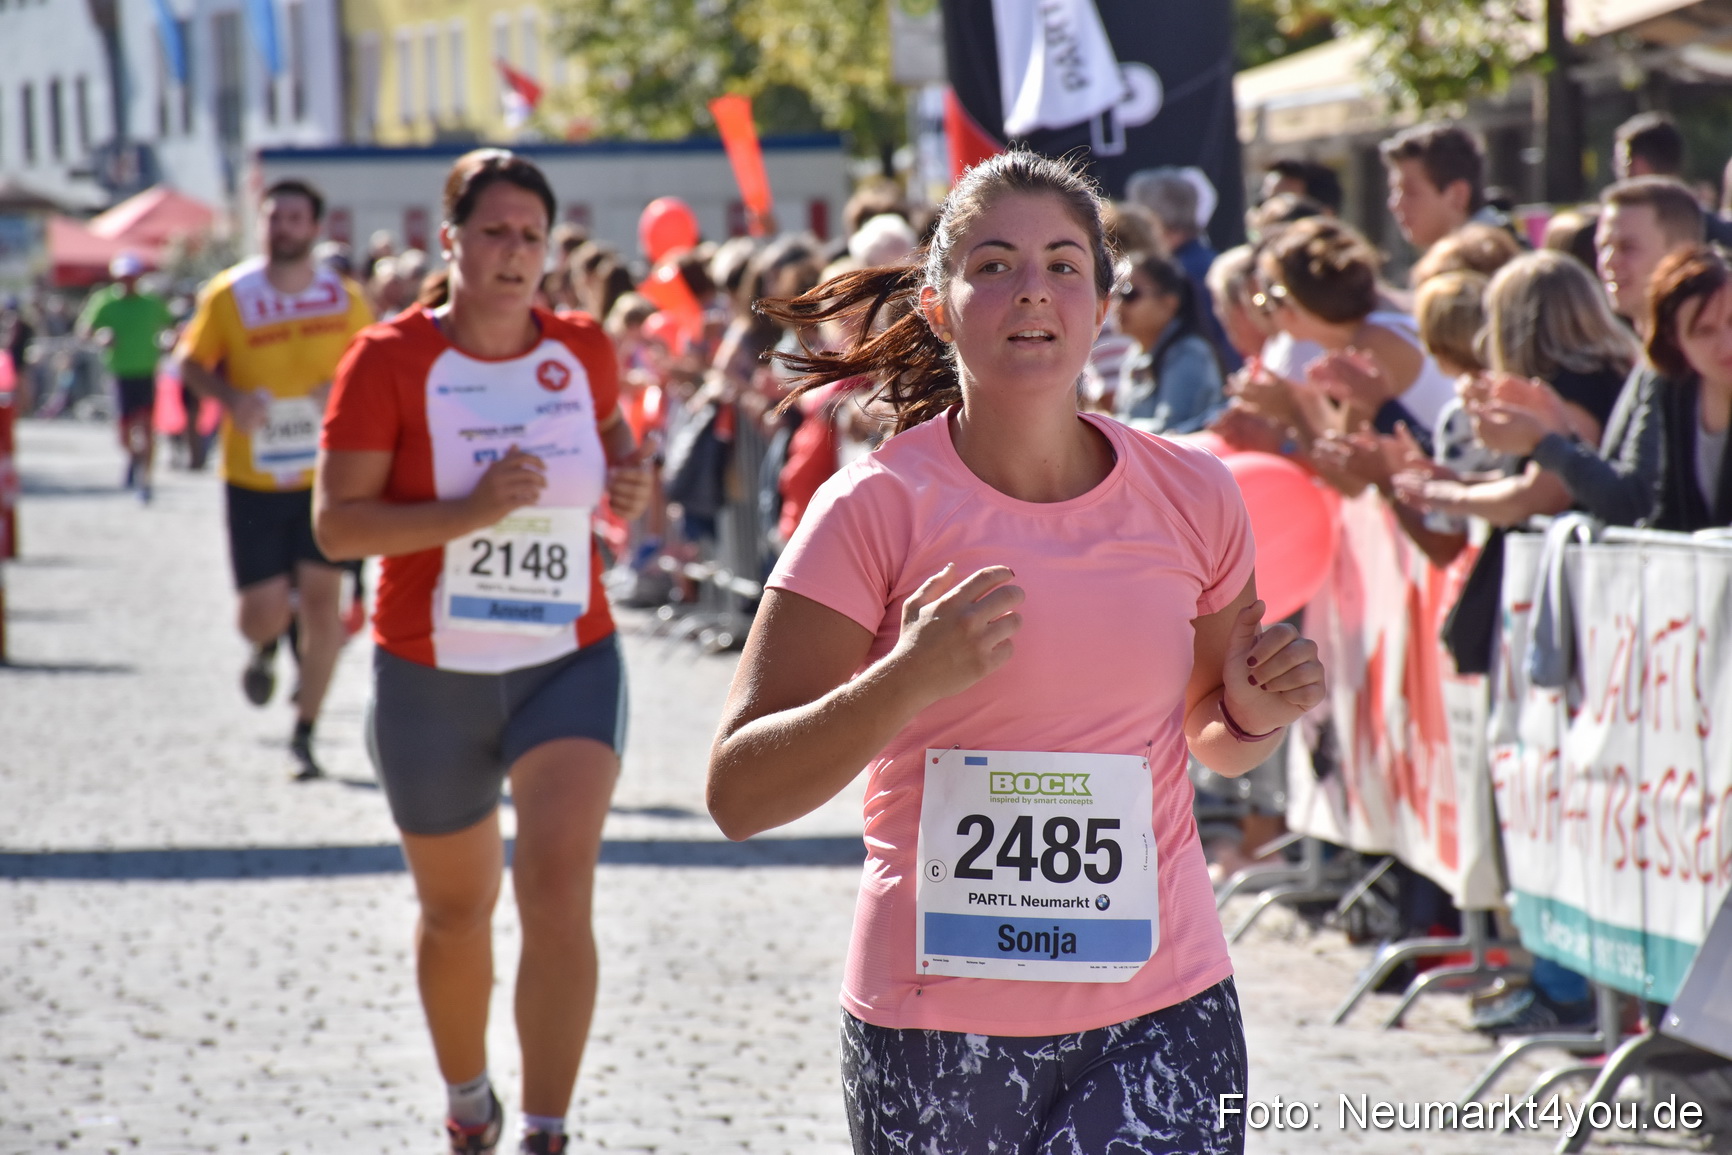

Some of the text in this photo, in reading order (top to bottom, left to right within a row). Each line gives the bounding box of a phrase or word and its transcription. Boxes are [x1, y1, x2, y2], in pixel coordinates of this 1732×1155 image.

[470, 538, 567, 582] 2148
[989, 771, 1092, 796] BOCK
[989, 796, 1020, 805] inspired
[1021, 796, 1032, 805] by
[1058, 798, 1094, 806] concepts
[954, 814, 1123, 885] 2485
[931, 865, 940, 877] C
[968, 892, 1090, 909] PARTL Neumarkt
[997, 923, 1077, 959] Sonja
